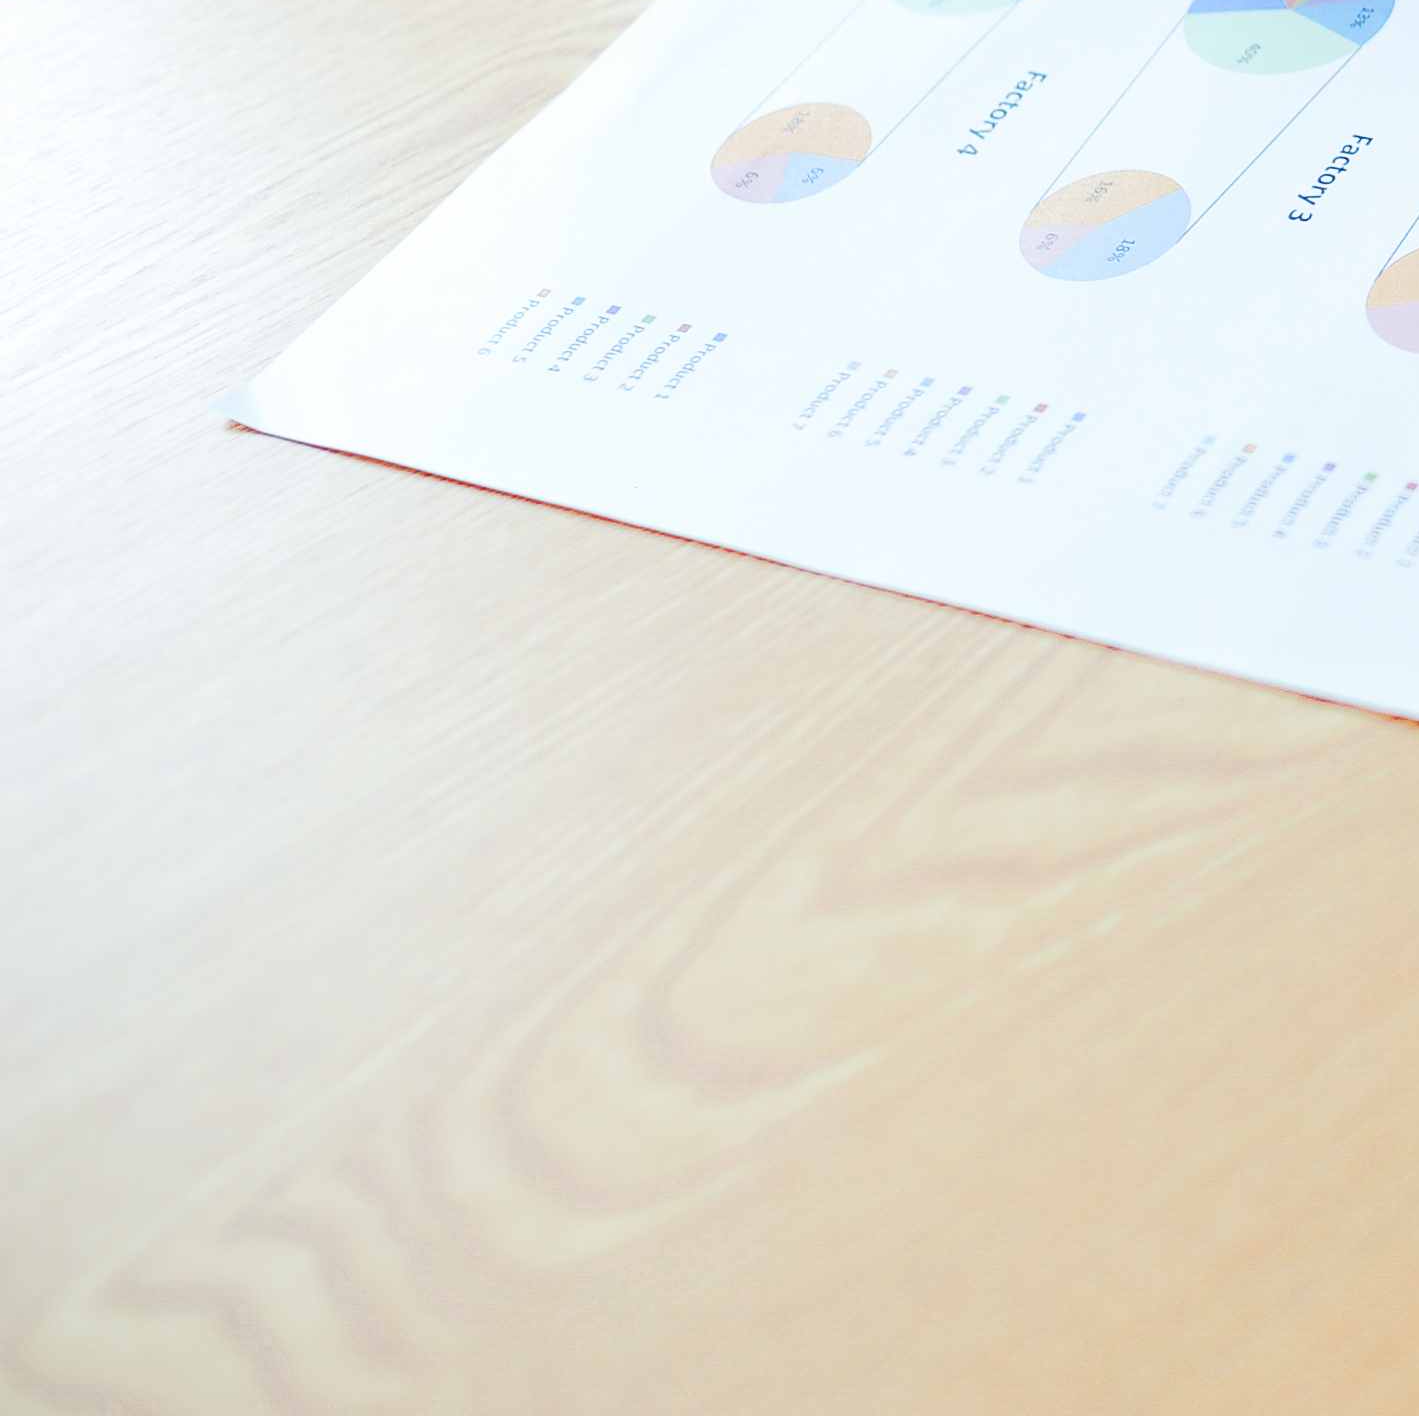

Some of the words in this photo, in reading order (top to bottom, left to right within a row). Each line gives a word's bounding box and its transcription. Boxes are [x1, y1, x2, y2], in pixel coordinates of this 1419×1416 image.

[969, 71, 1047, 139] Factory
[957, 144, 978, 155] 4
[1297, 134, 1374, 205] Factory
[1288, 209, 1313, 222] 3
[1106, 239, 1136, 264] 18%
[488, 299, 540, 345] Product
[522, 307, 574, 353] Product
[557, 315, 610, 362] Product
[593, 325, 645, 371] Product
[629, 334, 681, 380] Product
[664, 343, 716, 389] Product
